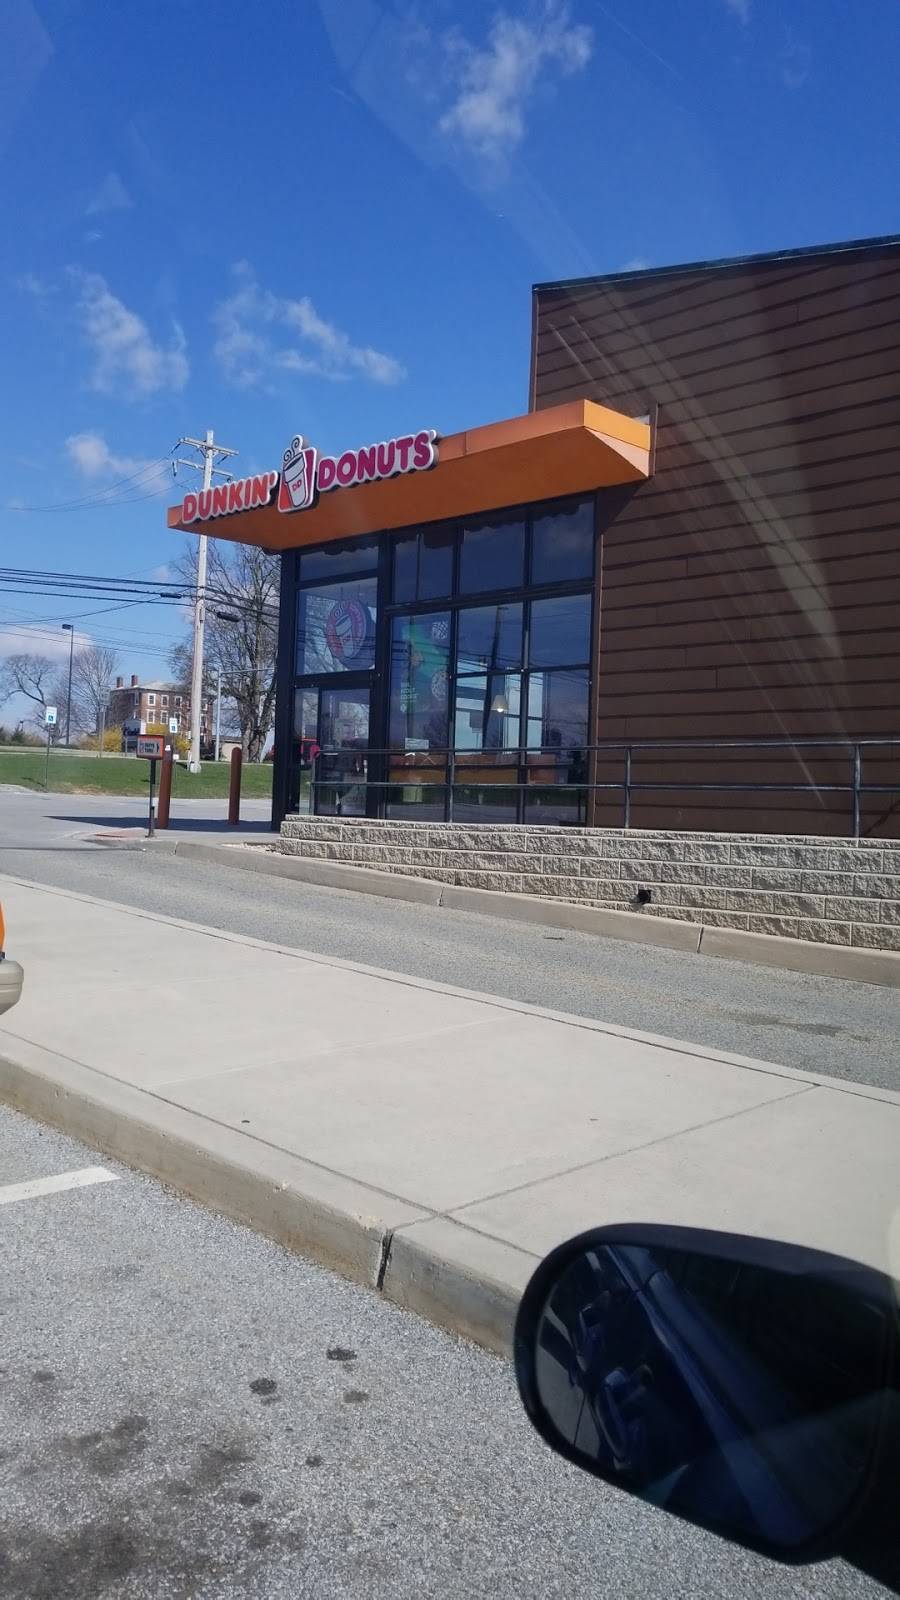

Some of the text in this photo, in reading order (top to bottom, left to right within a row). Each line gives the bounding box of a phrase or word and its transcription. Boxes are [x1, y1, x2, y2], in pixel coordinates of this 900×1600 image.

[183, 432, 431, 522] DUNKIN' DONUTS
[292, 479, 302, 491] DD
